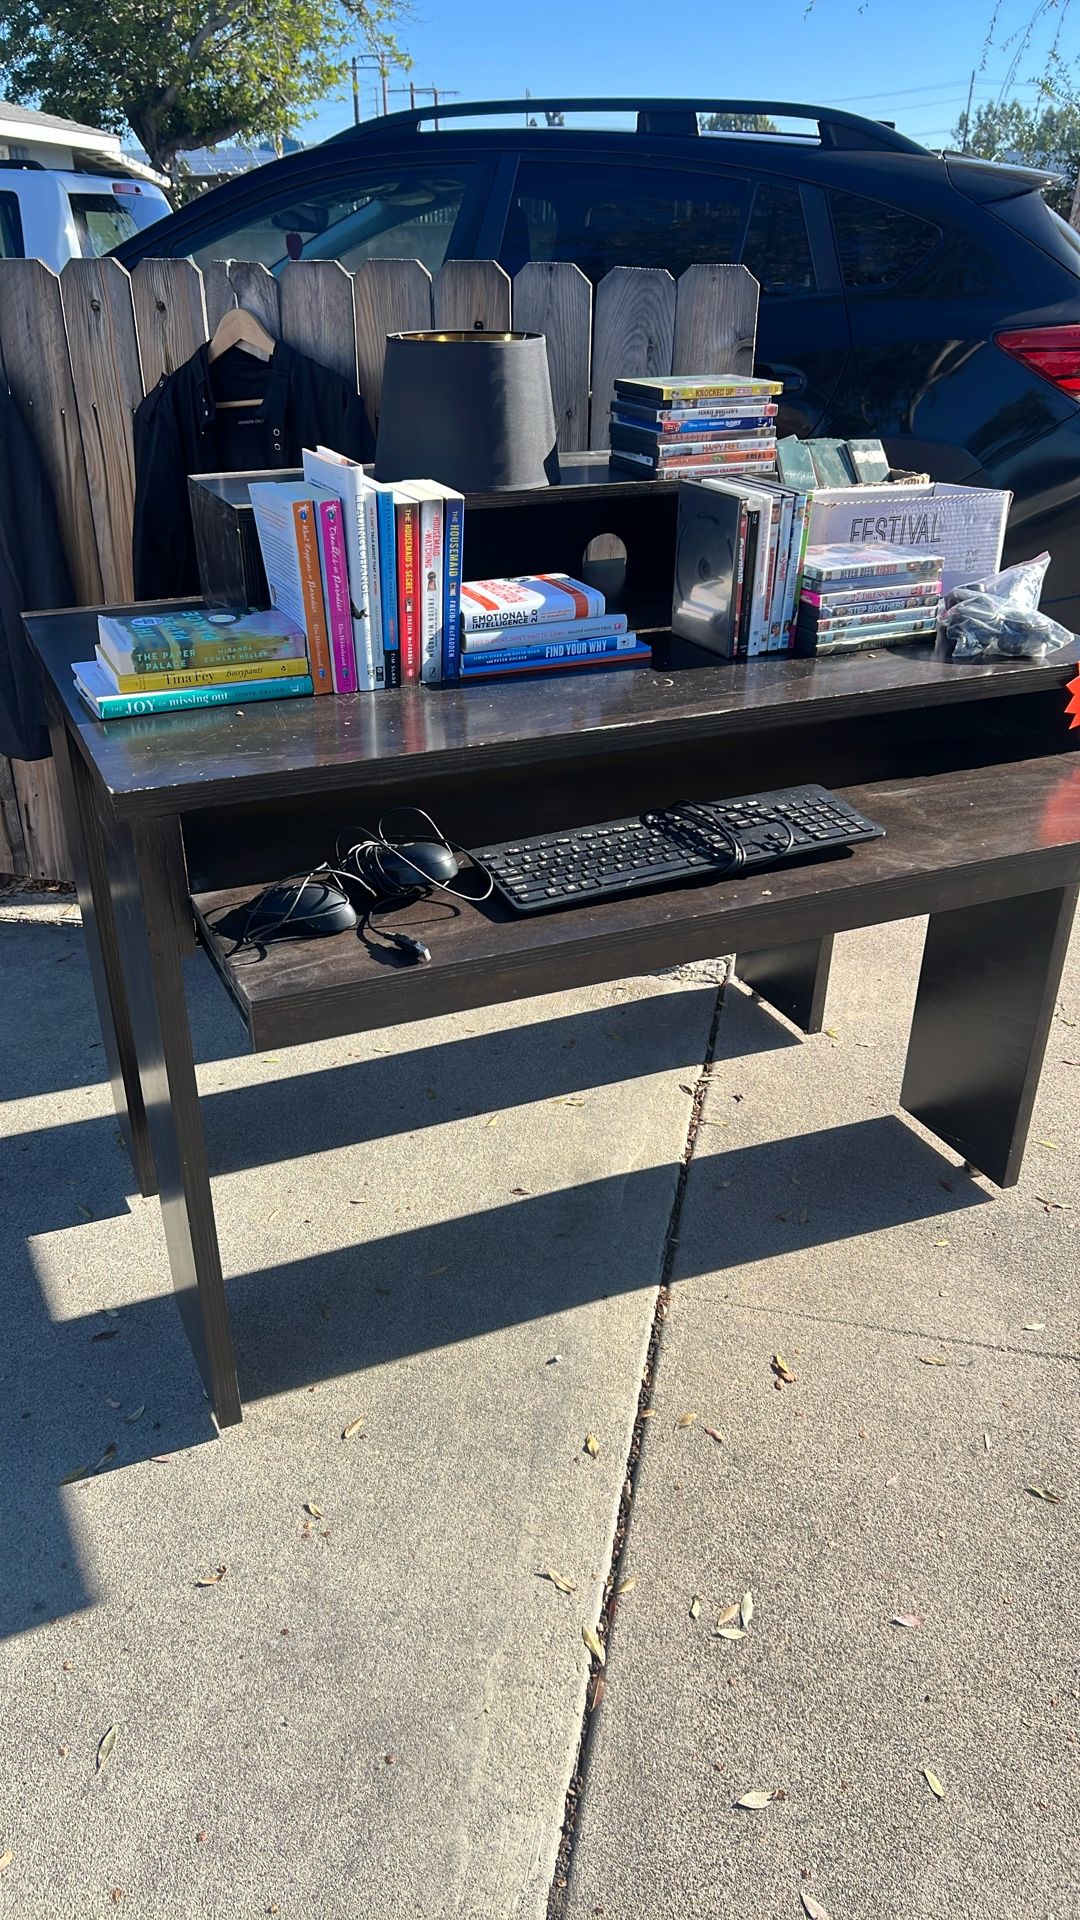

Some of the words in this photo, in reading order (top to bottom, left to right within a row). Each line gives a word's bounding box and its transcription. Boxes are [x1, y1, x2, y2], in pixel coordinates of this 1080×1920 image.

[695, 387, 725, 397] KNOCKED
[726, 387, 734, 396] UP
[726, 420, 741, 428] DORY
[702, 444, 723, 453] HAPPY
[725, 442, 740, 450] FEET
[355, 494, 366, 546] LEADING
[433, 516, 441, 557] HOUSEMAID
[849, 512, 943, 545] FESTIVAL
[328, 525, 341, 564] Troubles
[404, 524, 413, 568] HOUSEMAID'S
[425, 532, 433, 569] WATCHING
[449, 525, 460, 577] HOUSEMAID
[358, 549, 370, 599] CHANGE
[840, 568, 859, 580] NEVER
[875, 564, 898, 575] KISSED
[405, 569, 414, 594] SECRET
[332, 575, 345, 612] Paradise
[862, 591, 894, 600] DRESSES
[848, 604, 867, 615] STEP
[868, 601, 906, 612] BROTHERS
[472, 611, 528, 624] EMOTIONAL
[472, 618, 529, 630] INTELLIGENCE
[448, 625, 456, 658] McFADDEN
[545, 645, 564, 658] FIND
[566, 642, 587, 656] YOUR
[589, 639, 608, 653] WHY
[137, 652, 158, 662] THE
[162, 649, 197, 660] PAPER
[218, 646, 253, 654] MIRANDA
[146, 659, 187, 671] PALACE
[204, 654, 236, 663] COWLEY
[163, 672, 192, 685] Tina
[194, 670, 215, 684] Fey
[226, 667, 263, 679] Bossypants
[125, 699, 156, 714] JOY
[169, 694, 209, 707] missing
[212, 692, 228, 701] out
